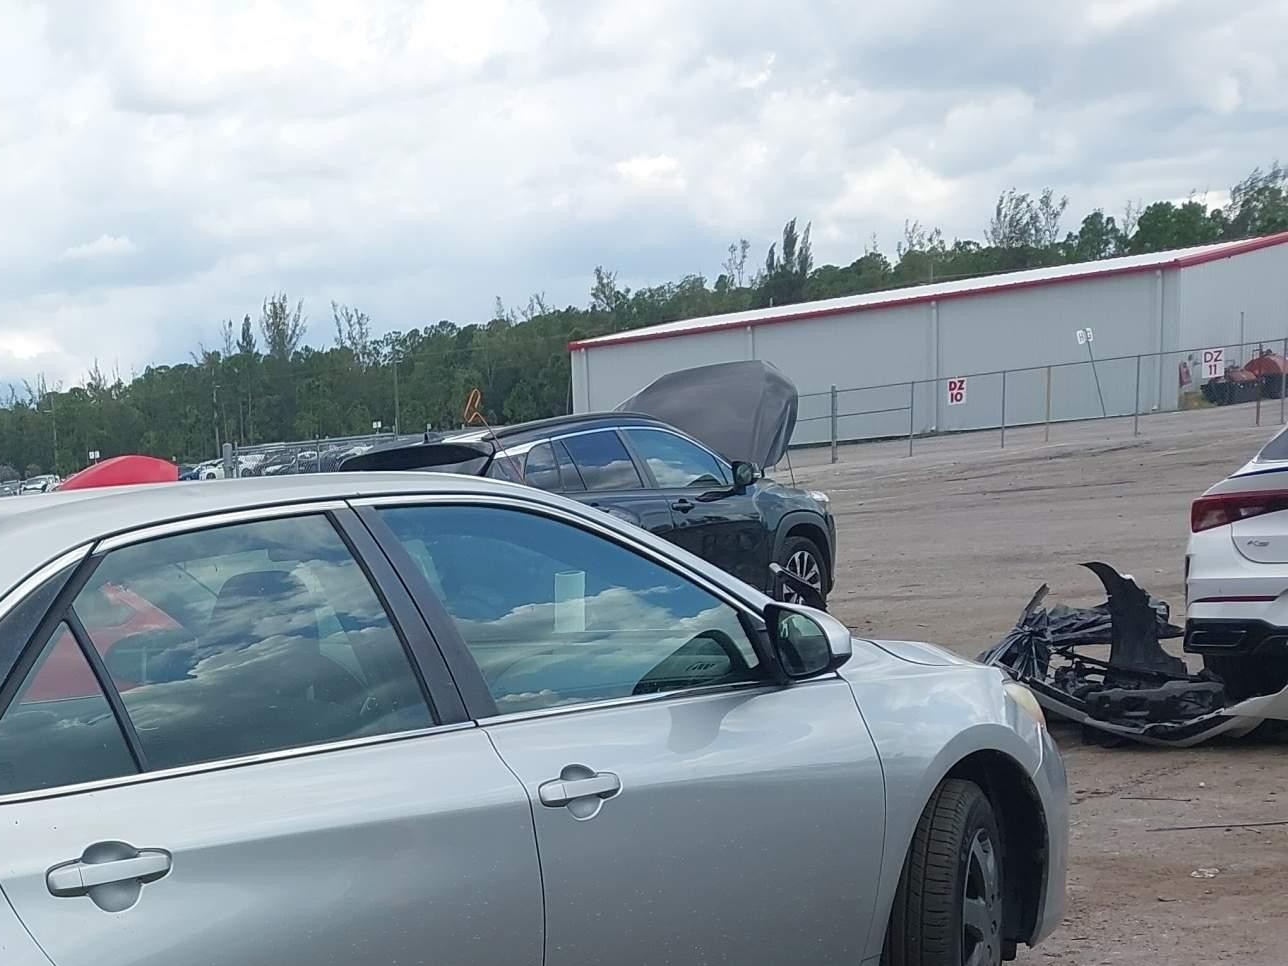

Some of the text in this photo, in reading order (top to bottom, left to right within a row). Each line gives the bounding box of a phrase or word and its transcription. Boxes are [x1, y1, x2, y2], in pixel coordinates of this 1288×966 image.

[1203, 350, 1223, 363] DZ
[1208, 363, 1217, 376] 11
[948, 379, 965, 392] DZ
[950, 391, 964, 404] 10
